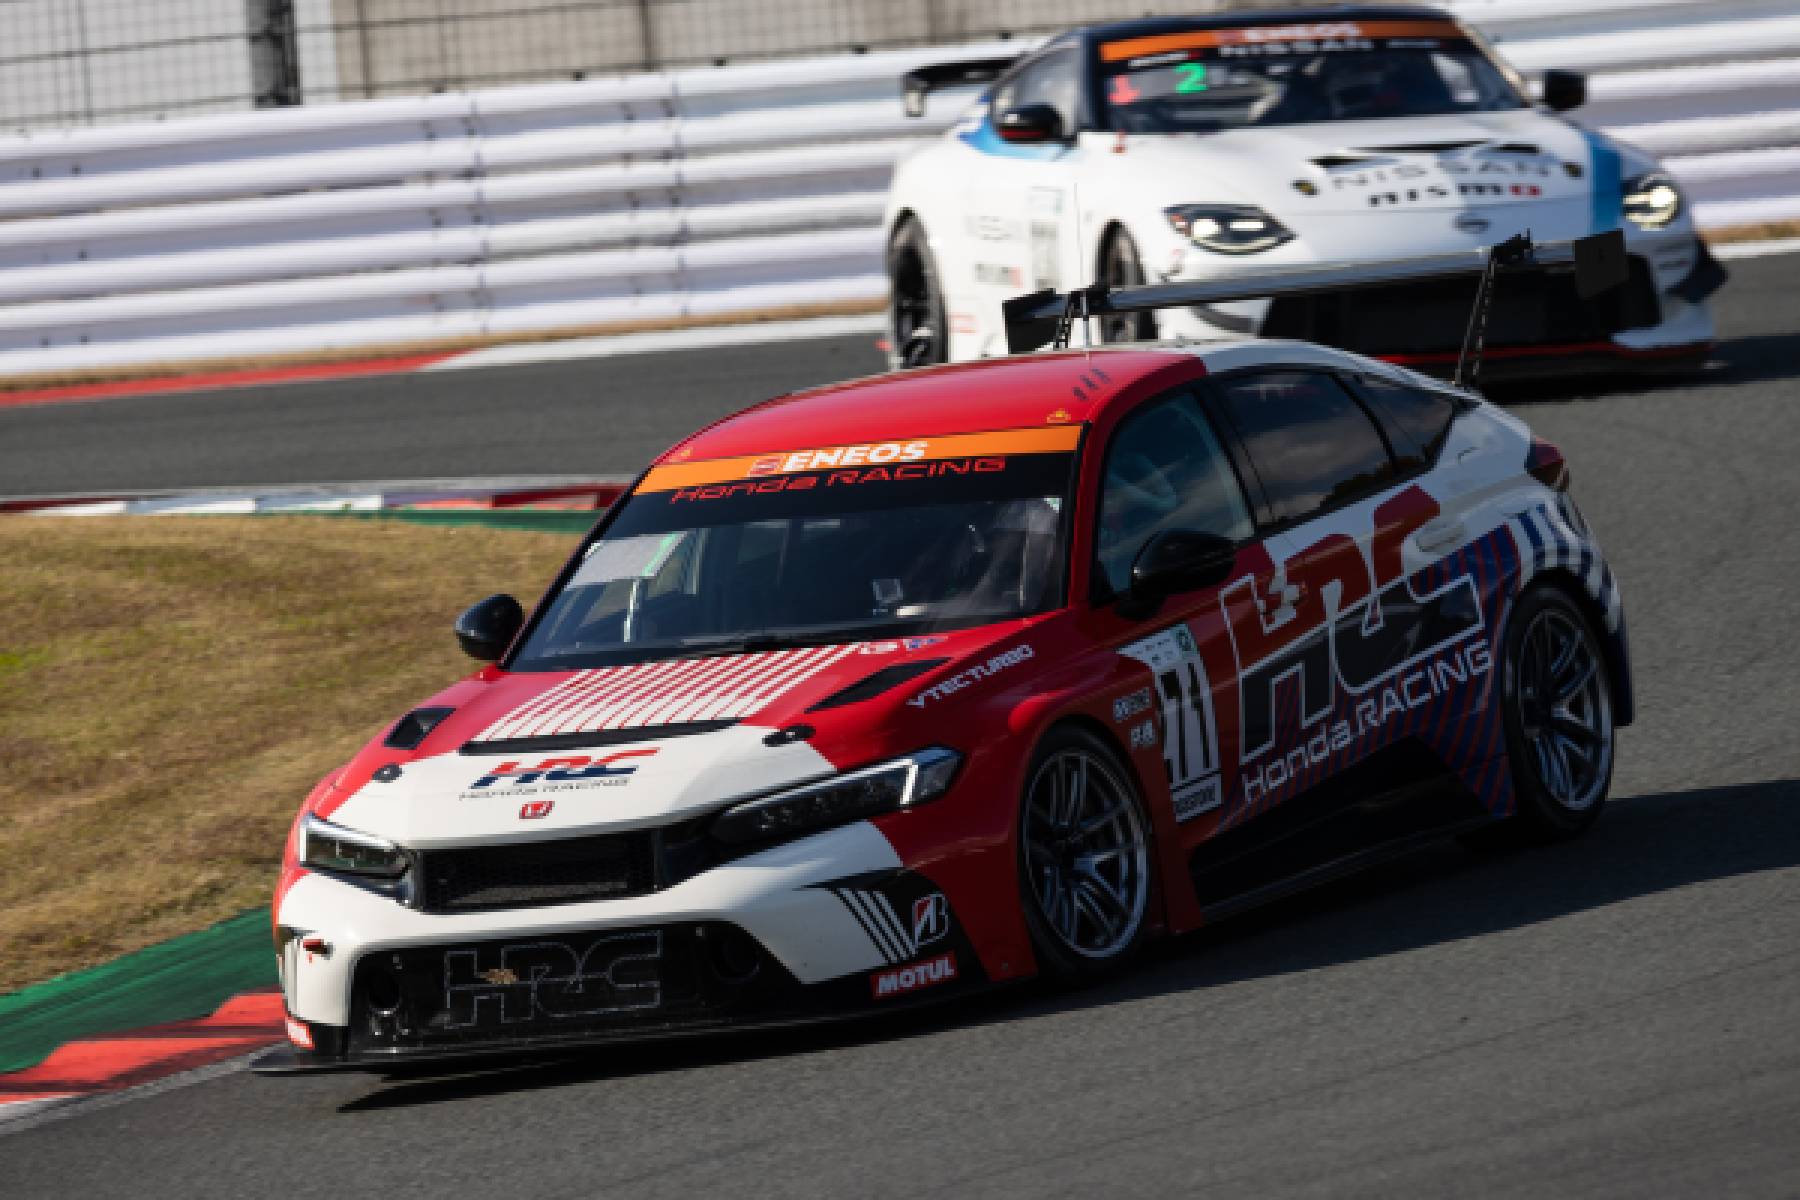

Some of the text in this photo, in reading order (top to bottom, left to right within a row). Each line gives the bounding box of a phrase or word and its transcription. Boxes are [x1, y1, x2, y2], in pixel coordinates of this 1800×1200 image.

[1174, 63, 1207, 94] 2
[779, 440, 929, 472] ENEOS
[827, 458, 1007, 487] RACING
[1241, 638, 1492, 802] Honda RACING
[469, 747, 661, 789] HRC
[443, 929, 663, 1030] HRC
[876, 956, 956, 995] MOTUL
